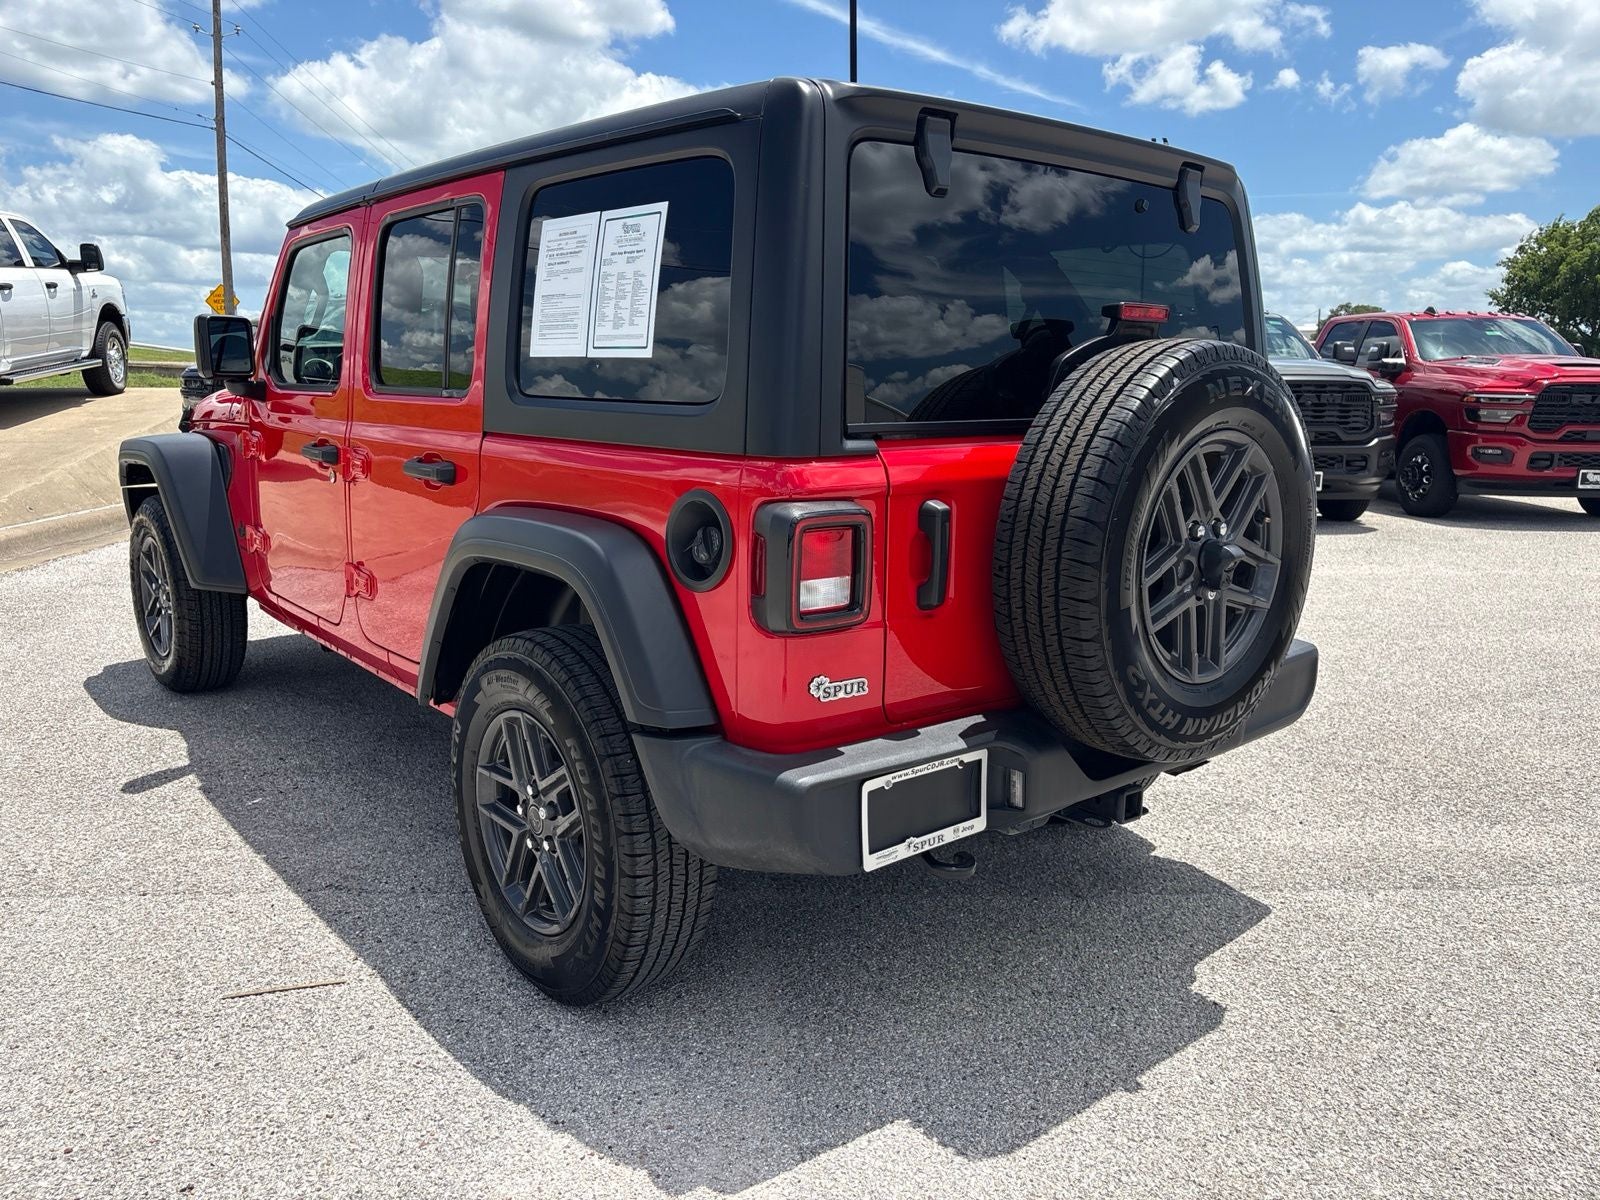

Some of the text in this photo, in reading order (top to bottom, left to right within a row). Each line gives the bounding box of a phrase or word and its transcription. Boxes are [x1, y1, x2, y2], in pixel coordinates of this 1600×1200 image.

[822, 681, 866, 699] SPUR
[1126, 659, 1275, 736] ROADIAN HTX2
[891, 757, 960, 781] www.SpurCDJR.com
[565, 737, 605, 911] ROADIAN
[961, 824, 975, 833] Jeep
[912, 834, 945, 853] SPUR
